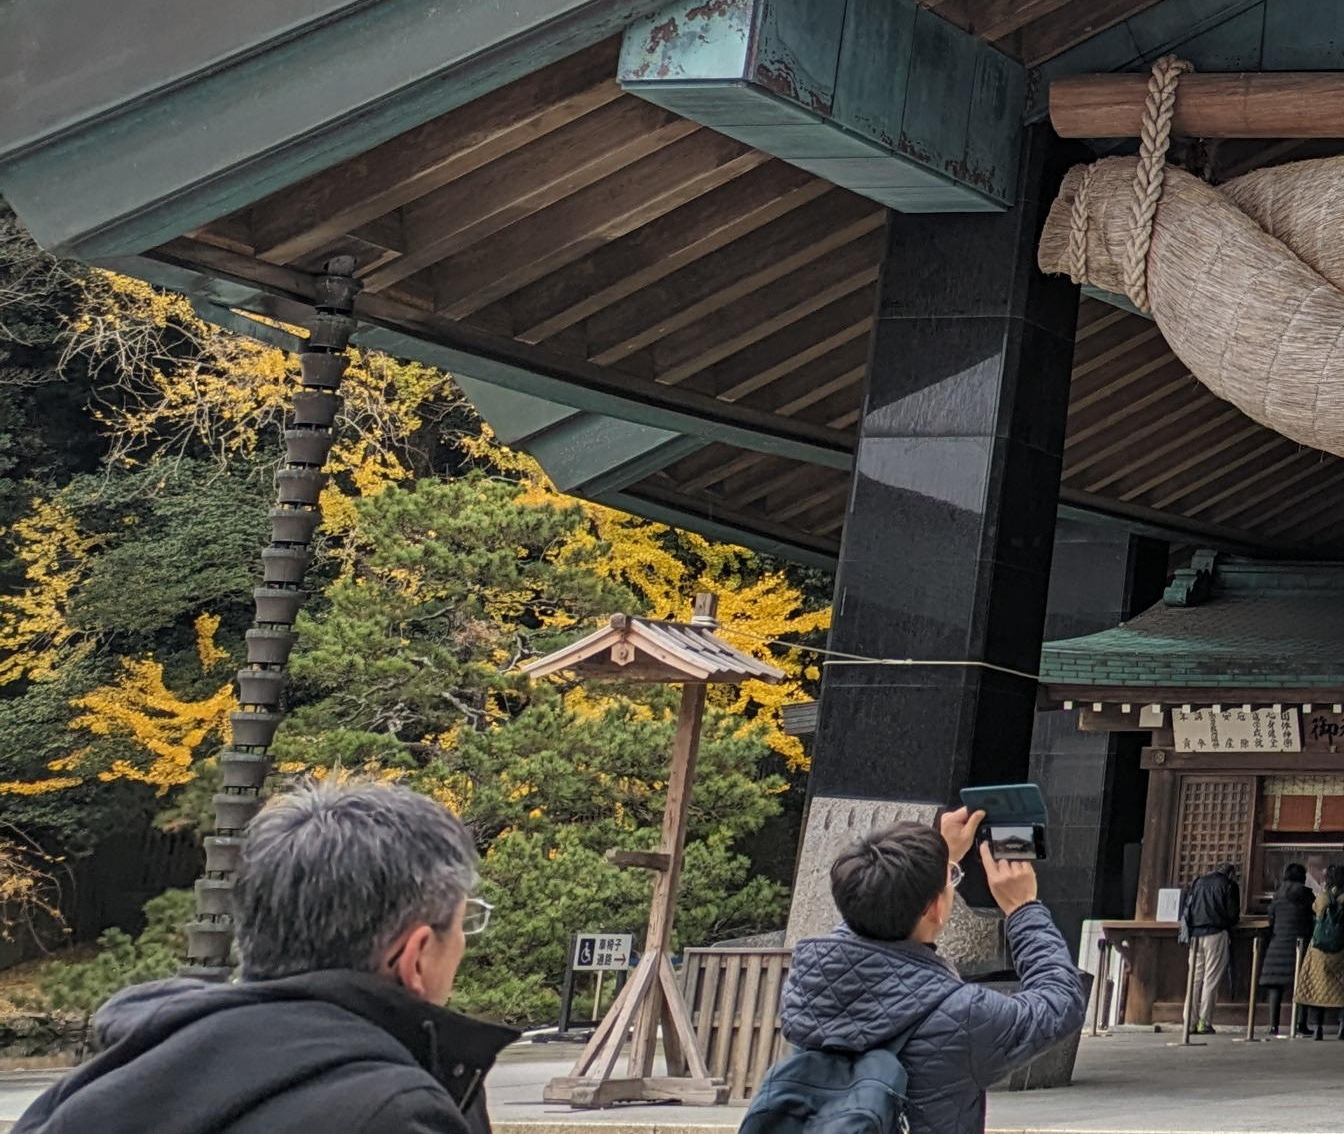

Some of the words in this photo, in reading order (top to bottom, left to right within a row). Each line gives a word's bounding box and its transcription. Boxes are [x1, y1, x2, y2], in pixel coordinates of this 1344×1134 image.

[598, 938, 622, 951] 車椅子
[595, 953, 613, 966] 通路
